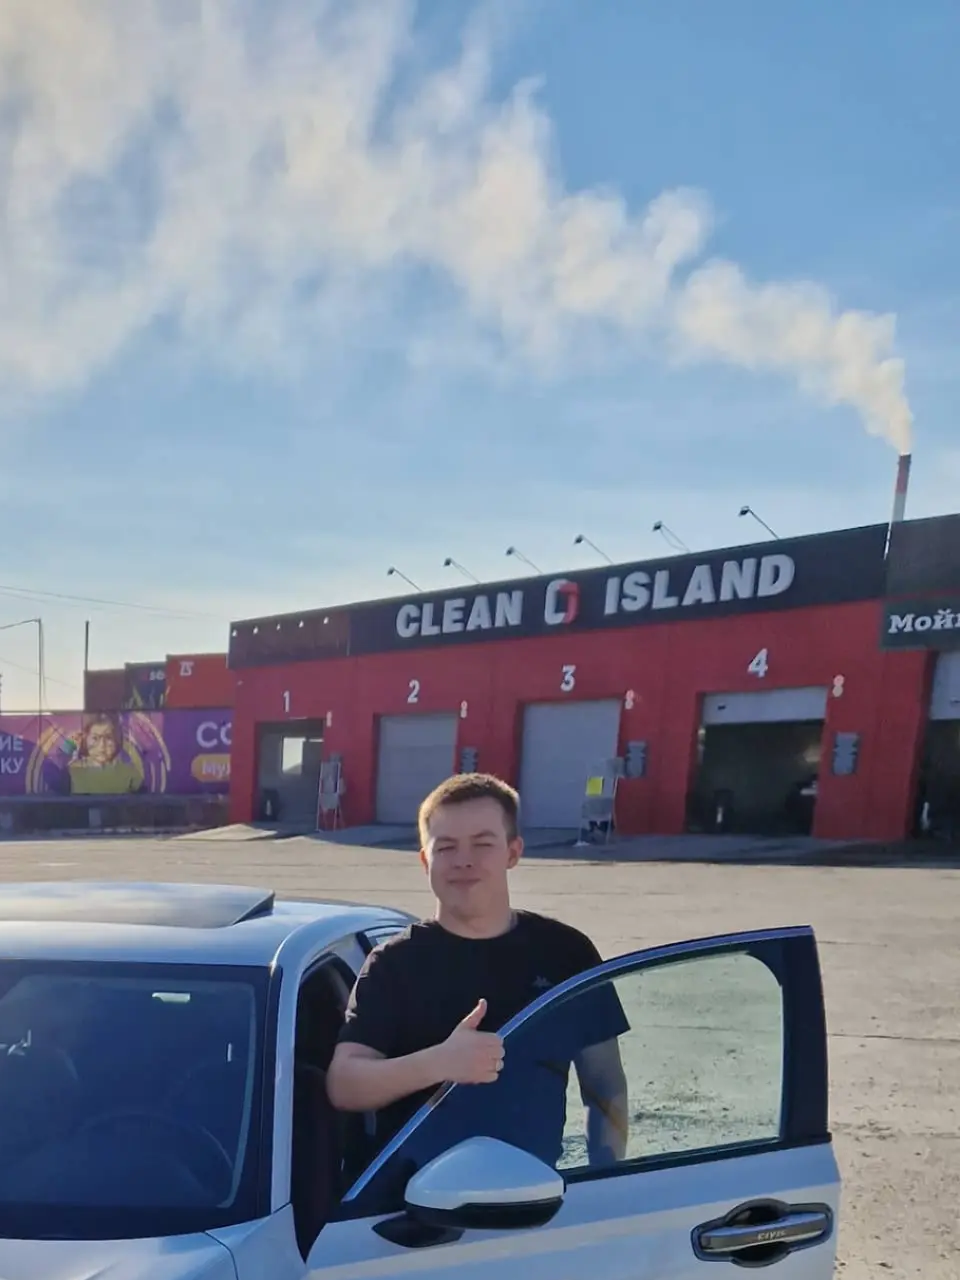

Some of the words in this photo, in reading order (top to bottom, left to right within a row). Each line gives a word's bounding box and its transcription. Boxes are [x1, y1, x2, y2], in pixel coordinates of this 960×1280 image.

[396, 591, 523, 638] CLEAN
[604, 554, 796, 615] ISLAND
[887, 608, 960, 634] Мой
[748, 648, 769, 678] 4
[407, 679, 420, 704] 2
[560, 664, 576, 692] 3
[283, 690, 291, 713] 1
